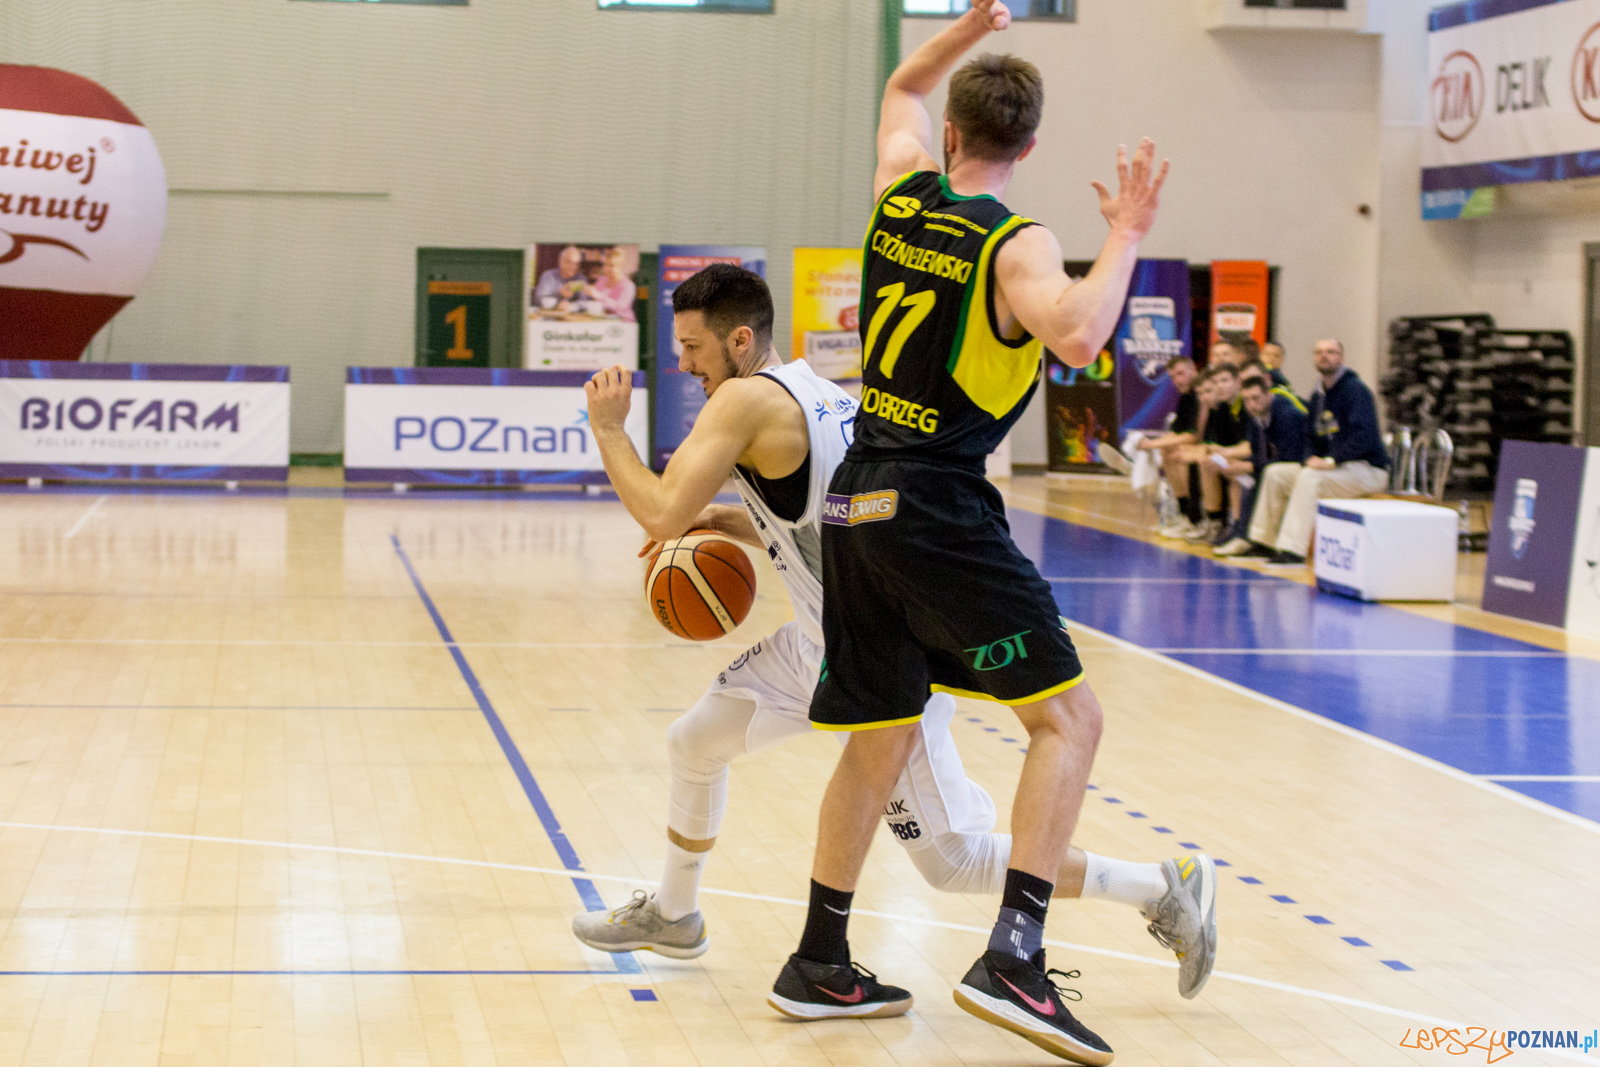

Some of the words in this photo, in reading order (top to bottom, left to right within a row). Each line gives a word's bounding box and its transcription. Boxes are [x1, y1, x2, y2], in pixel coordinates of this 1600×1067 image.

[445, 305, 474, 360] 1
[863, 281, 937, 379] 11
[20, 396, 240, 432] BIOFARM
[964, 629, 1033, 671] ZOT
